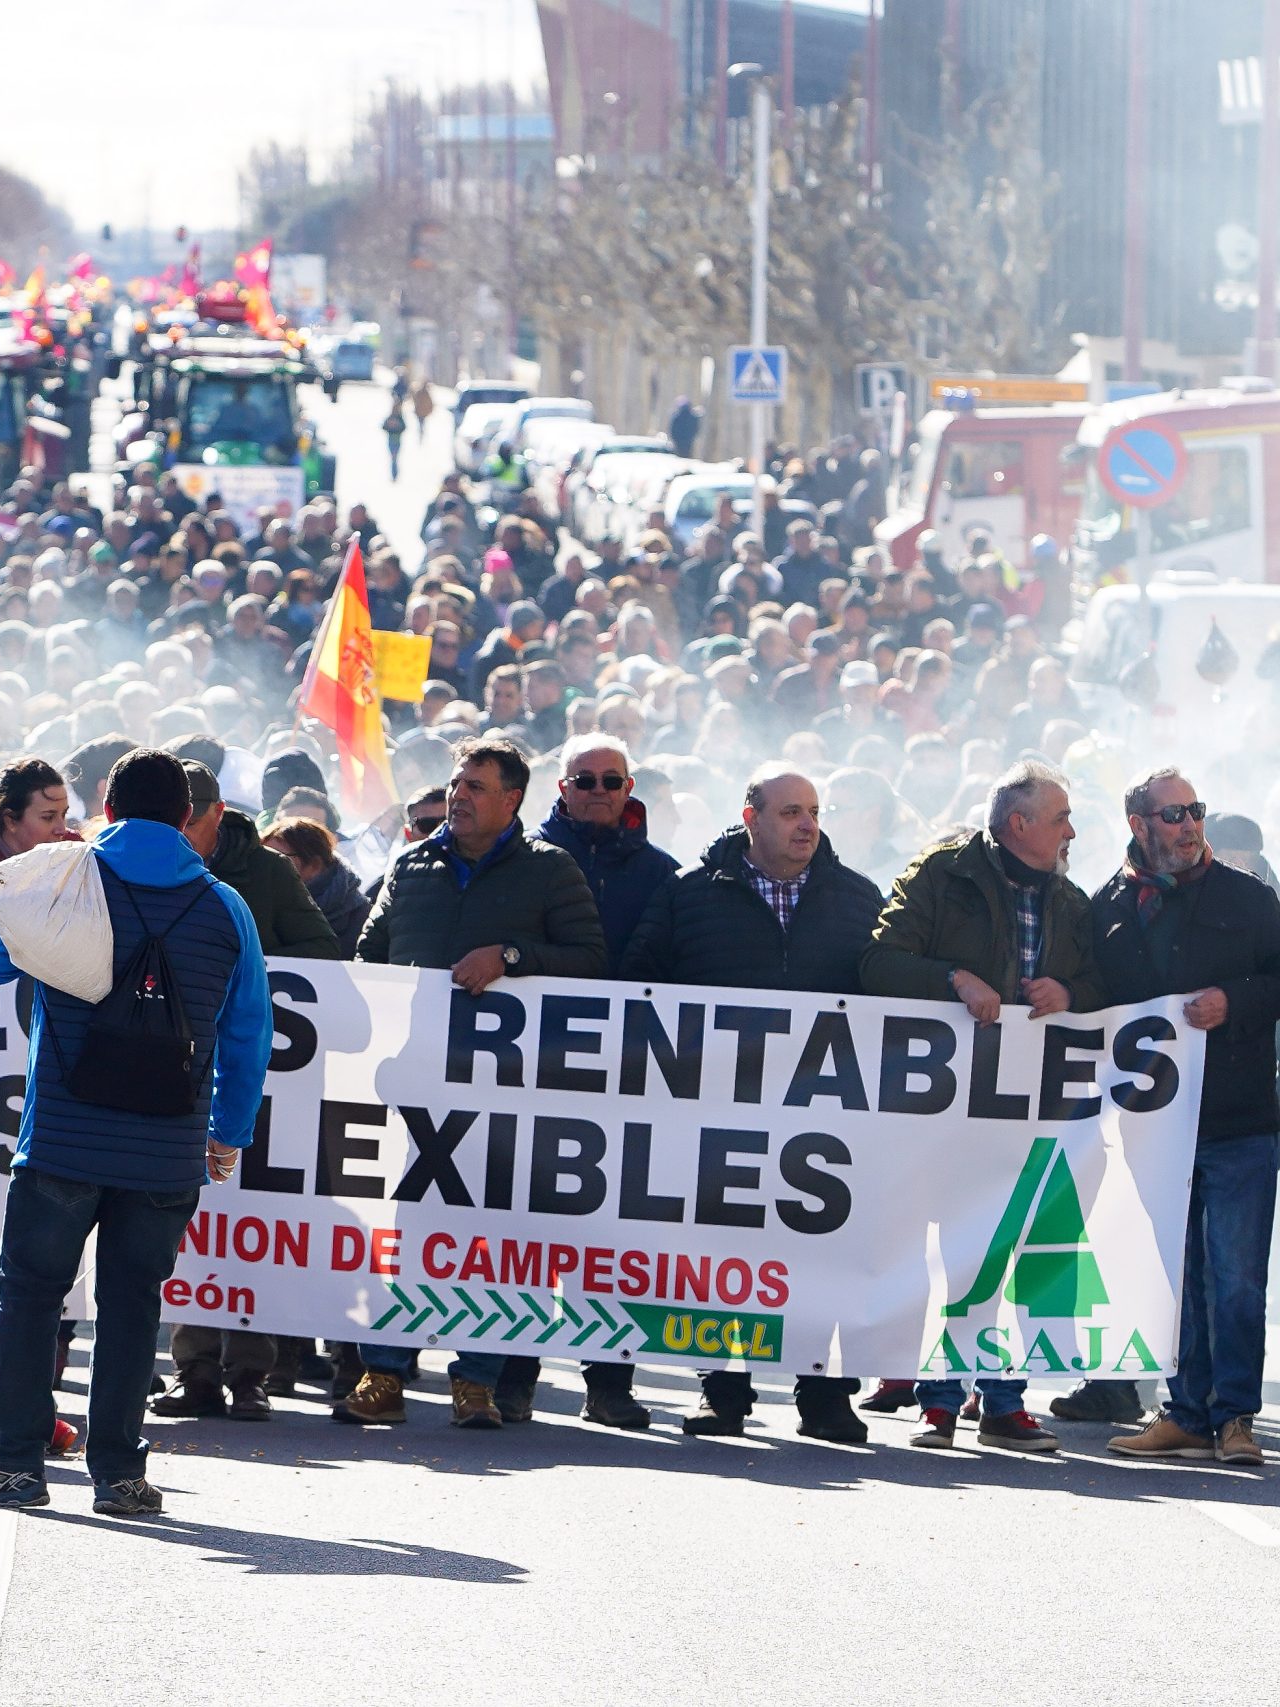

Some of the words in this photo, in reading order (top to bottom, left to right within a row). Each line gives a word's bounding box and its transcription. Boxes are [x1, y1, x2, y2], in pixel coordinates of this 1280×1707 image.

[445, 988, 1180, 1121] RENTABLES
[240, 1094, 853, 1235] LEXIBLES
[163, 1274, 256, 1315] eón
[178, 1210, 310, 1268] NION
[331, 1224, 403, 1276] DE
[422, 1231, 790, 1308] CAMPESINOS
[662, 1312, 775, 1358] UCCL
[920, 1326, 1163, 1373] ASAJA
